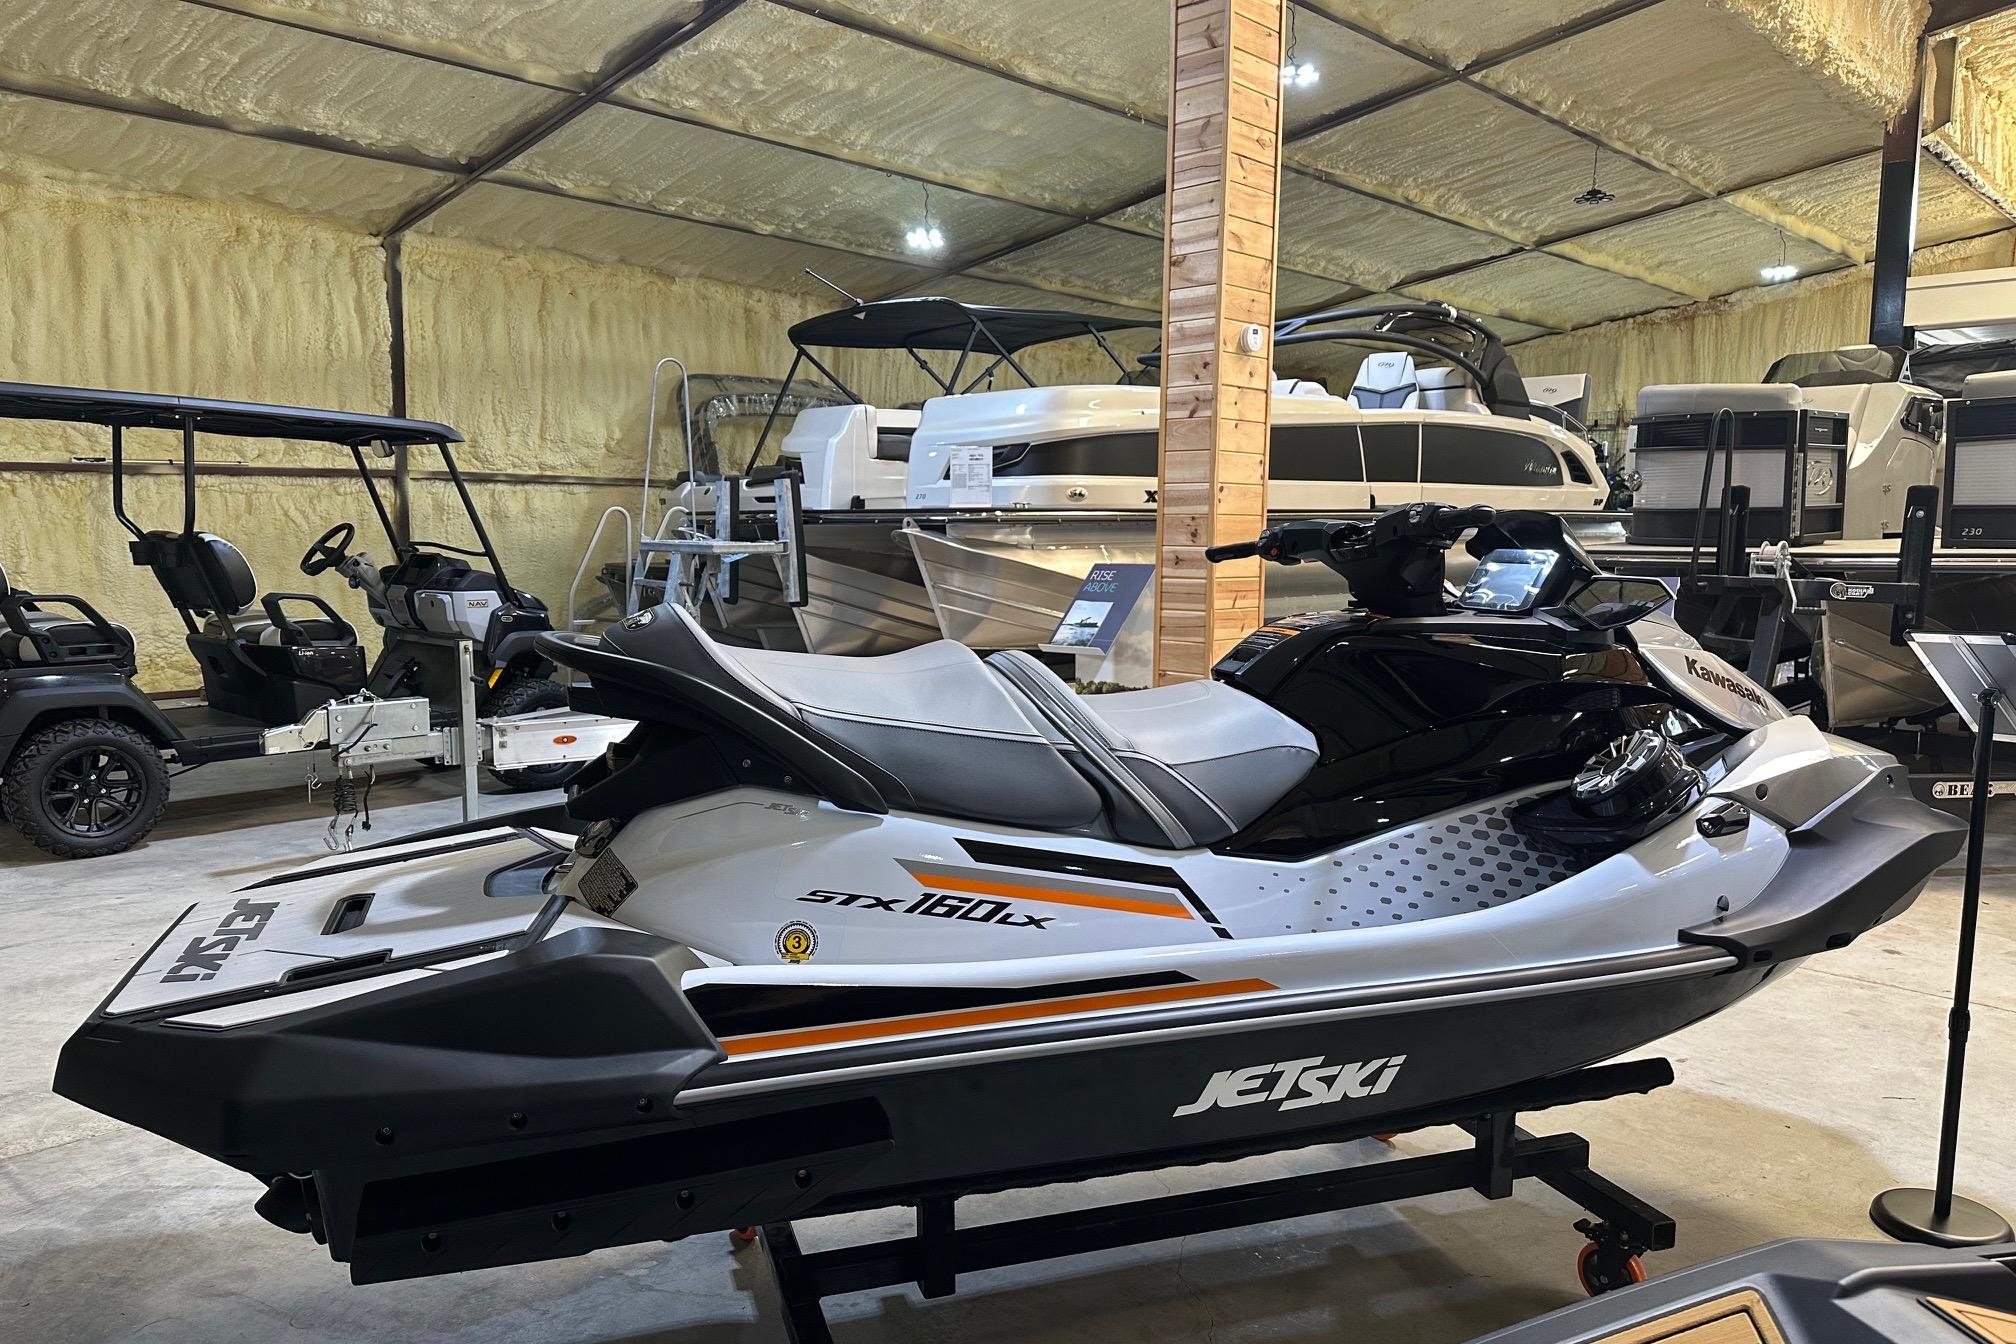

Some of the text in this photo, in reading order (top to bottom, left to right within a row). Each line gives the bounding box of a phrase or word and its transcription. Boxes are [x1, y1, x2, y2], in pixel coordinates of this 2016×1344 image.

[1089, 570, 1117, 580] RISE
[1082, 582, 1119, 592] ABOVE
[1684, 655, 1770, 711] Kawasaki
[1948, 784, 1993, 795] BE
[796, 889, 906, 911] STX
[792, 935, 802, 949] 3
